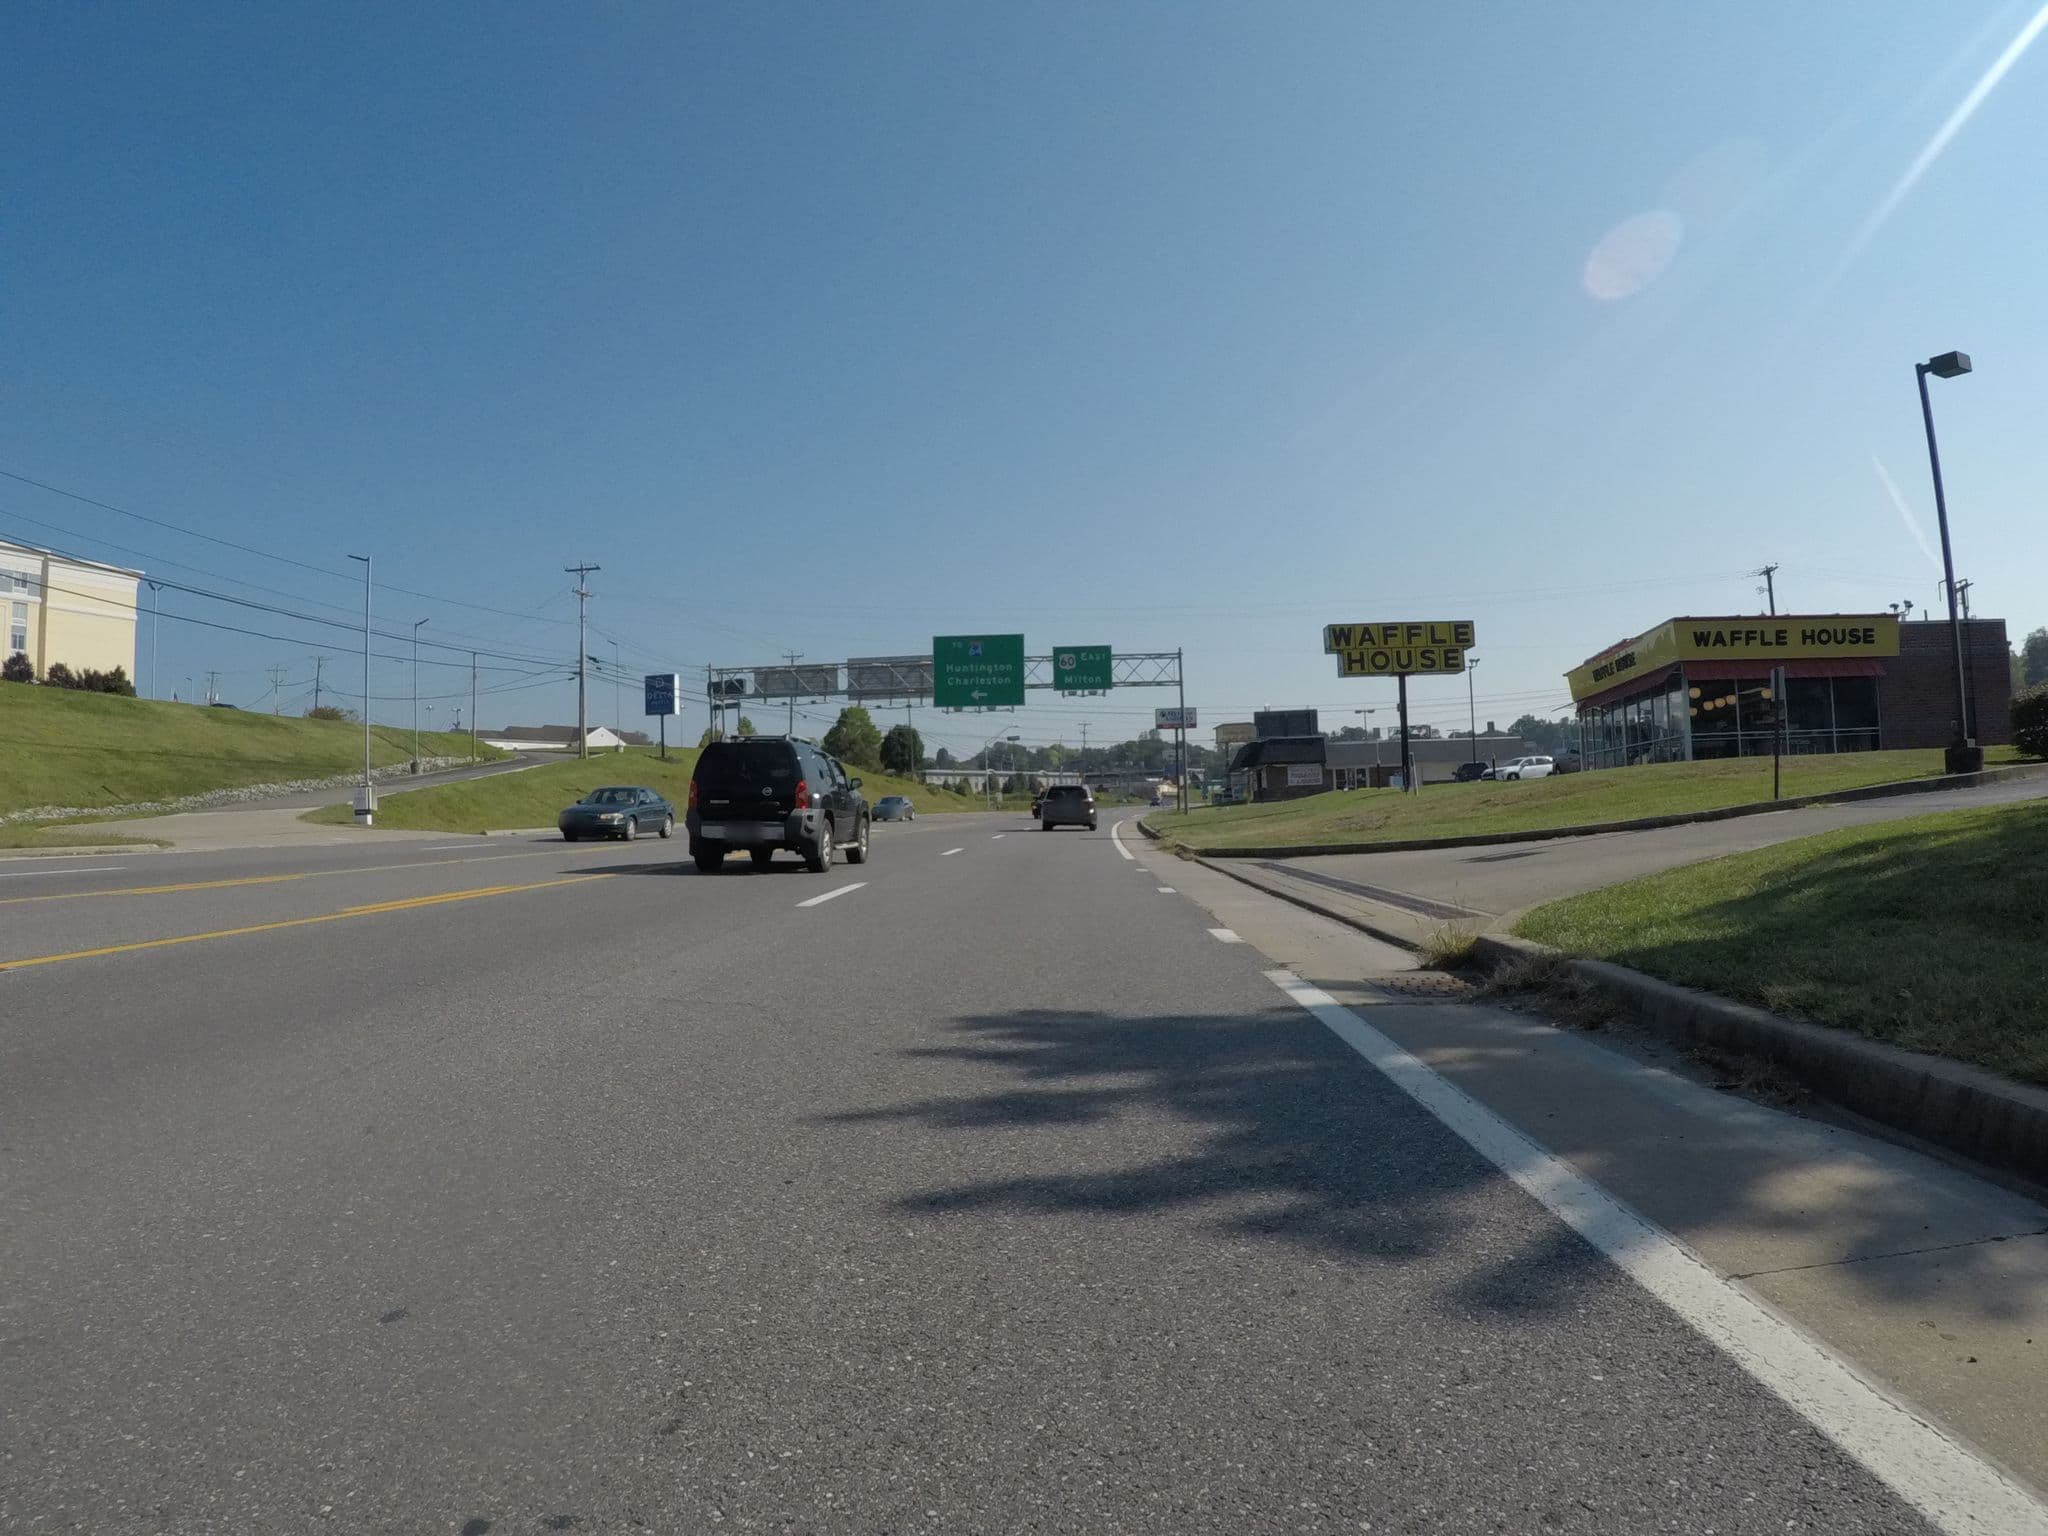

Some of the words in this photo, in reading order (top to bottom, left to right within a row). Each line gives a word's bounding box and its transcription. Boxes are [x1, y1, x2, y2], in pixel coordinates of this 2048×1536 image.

[1332, 624, 1471, 647] WAFFLE
[1693, 629, 1788, 647] WAFFLE
[1801, 628, 1876, 645] HOUSE
[1060, 656, 1074, 667] 60
[1347, 649, 1461, 671] HOUSE
[946, 664, 1013, 674] Huntington
[946, 676, 1011, 686] Charleston
[1064, 674, 1102, 684] Milton
